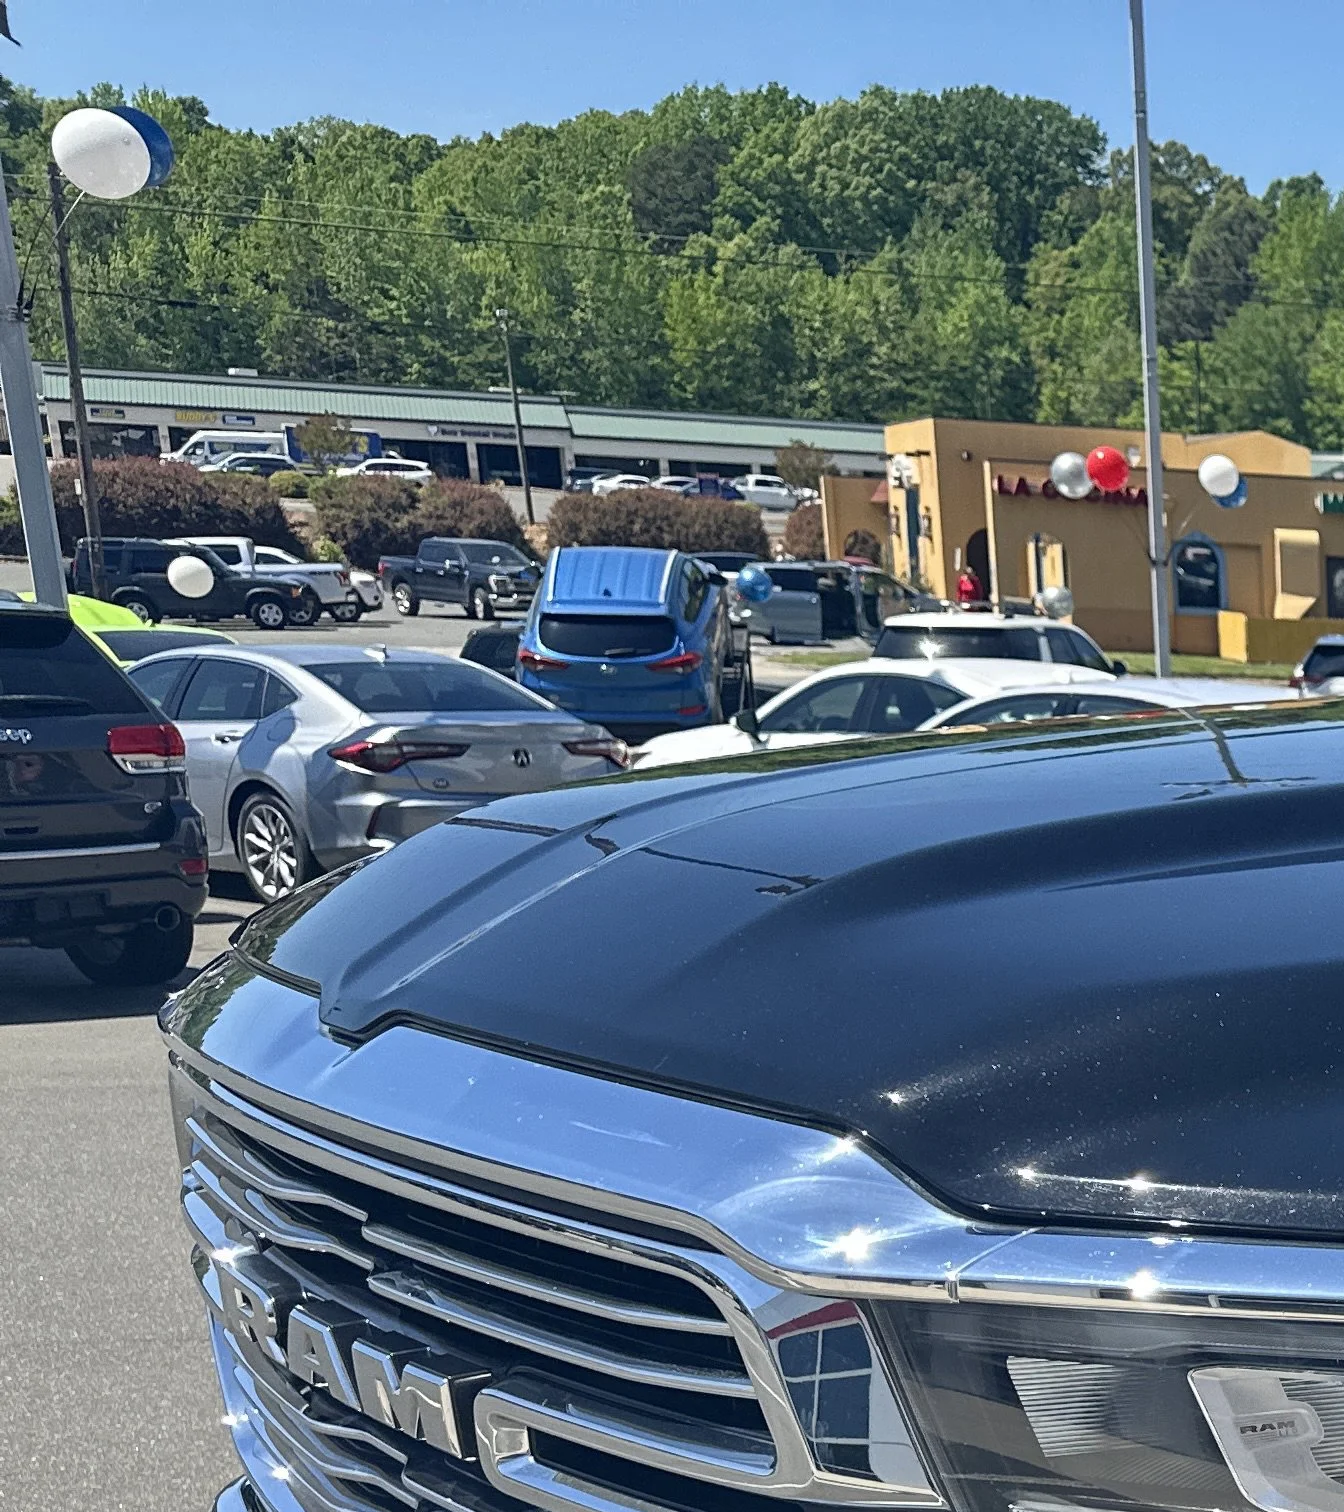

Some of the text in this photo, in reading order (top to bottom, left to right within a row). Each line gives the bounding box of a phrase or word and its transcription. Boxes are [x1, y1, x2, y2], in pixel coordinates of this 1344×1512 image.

[0, 728, 32, 745] eep
[218, 1258, 472, 1461] RAM
[1240, 1420, 1295, 1434] RAM
